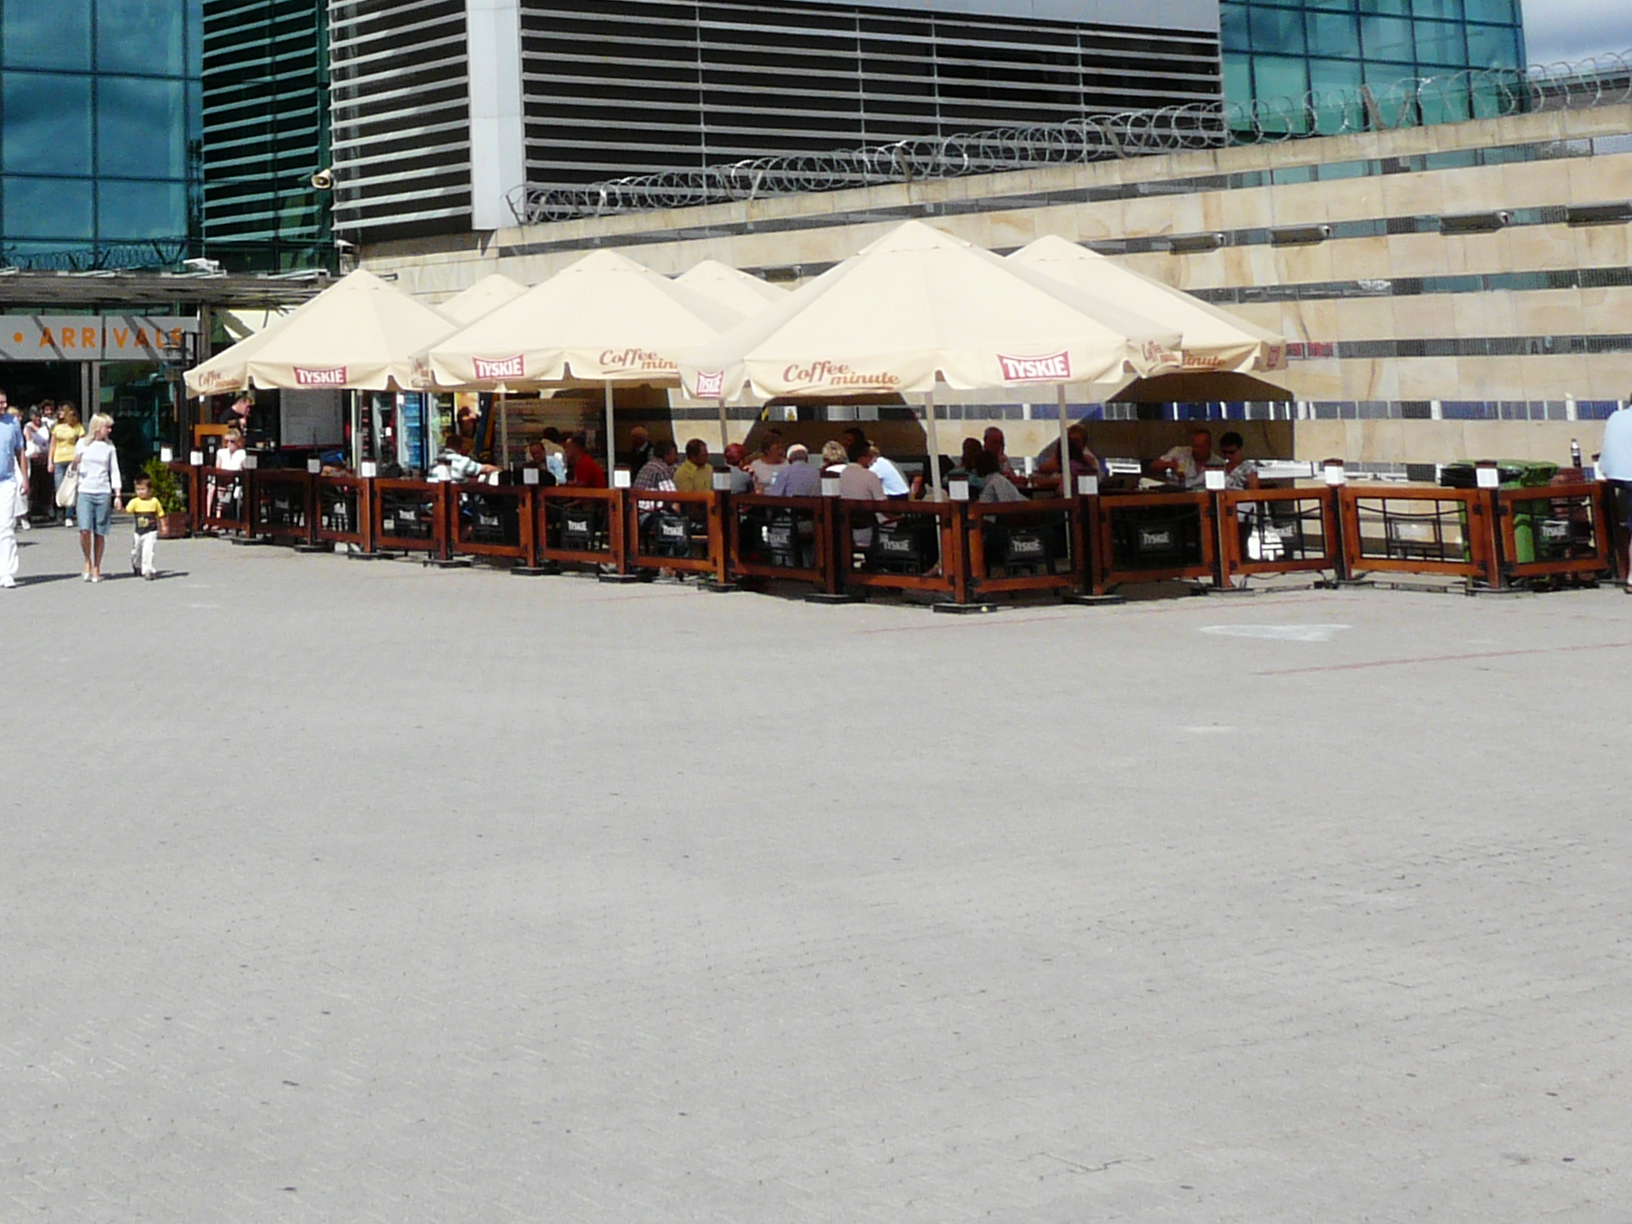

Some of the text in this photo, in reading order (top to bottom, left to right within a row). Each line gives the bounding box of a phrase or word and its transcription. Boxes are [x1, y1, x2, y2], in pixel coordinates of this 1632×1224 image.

[39, 326, 183, 350] ARRIVALS
[599, 348, 658, 367] Coffee
[1002, 356, 1068, 378] TYSKIE
[297, 369, 345, 383] TYSKIE
[476, 359, 523, 378] TYSKIE
[783, 360, 849, 383] Coffee
[830, 371, 900, 386] minute
